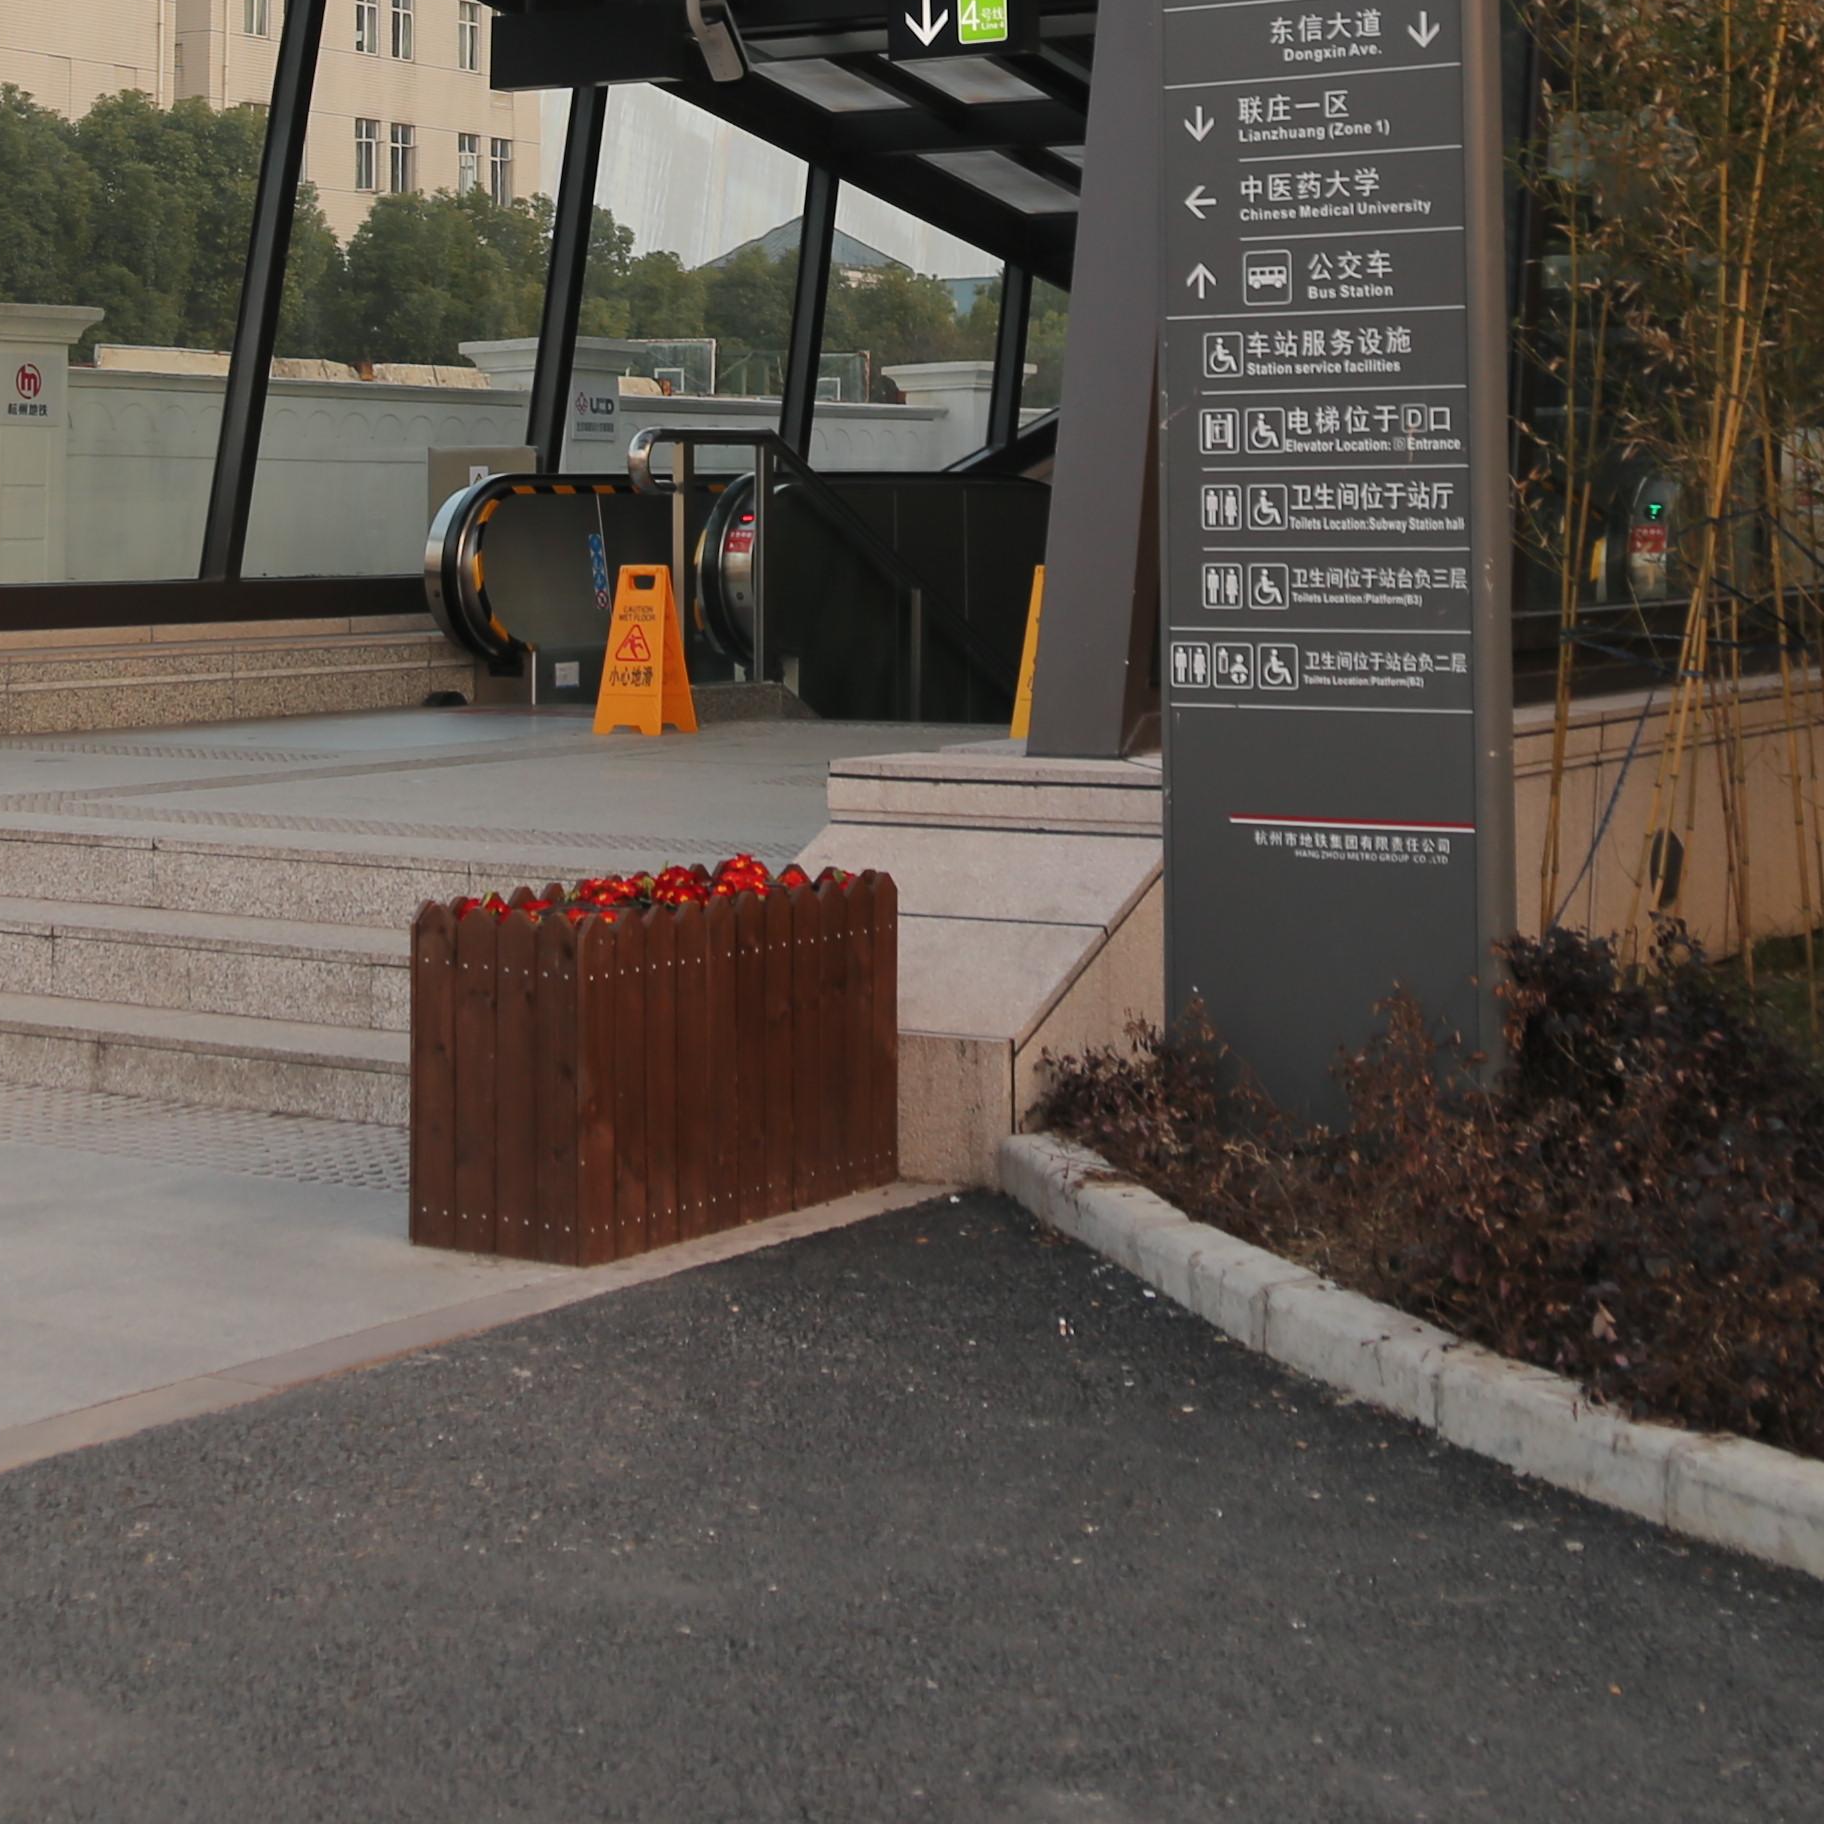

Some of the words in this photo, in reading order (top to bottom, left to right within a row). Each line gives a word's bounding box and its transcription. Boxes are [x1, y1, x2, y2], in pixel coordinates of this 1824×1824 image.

[1270, 8, 1382, 44] 东信大道
[1284, 45, 1347, 63] Dongxin
[1349, 43, 1383, 57] Ave.
[1238, 90, 1349, 124] 联庄一区
[1238, 125, 1325, 143] Lianzhuang
[1328, 122, 1372, 139] (Zone
[1376, 119, 1391, 136] 1)
[1240, 168, 1380, 204] 中医药大学
[1240, 206, 1297, 222] Chinese
[1299, 203, 1355, 219] Medical
[1358, 199, 1432, 216] University
[1308, 250, 1393, 282] 公交车
[1308, 286, 1336, 300] Bus
[1340, 284, 1393, 298] Station
[1247, 326, 1412, 358] 车站服务设施
[1247, 361, 1293, 376] Station
[1294, 361, 1342, 374] service
[1344, 359, 1401, 373] facilities
[1285, 438, 1334, 452] Elevator
[1336, 438, 1392, 452] Location:
[1406, 437, 1461, 450] Entrance
[1290, 481, 1454, 511] 卫生间位于站厅
[1288, 516, 1322, 530] Toilets
[1408, 518, 1445, 530] Station
[1445, 517, 1465, 530] hall
[1291, 568, 1468, 589] 卫生间位于站台负三层
[1291, 592, 1323, 604] Toilets
[1305, 651, 1468, 673] 卫生间位于站台负二层
[609, 666, 653, 687] 小心地滑
[1303, 675, 1331, 685] Toilets
[1254, 829, 1450, 854] 杭州市地铁集团有限责任公司
[1347, 852, 1378, 862] METRO
[1379, 853, 1410, 863] GROUP
